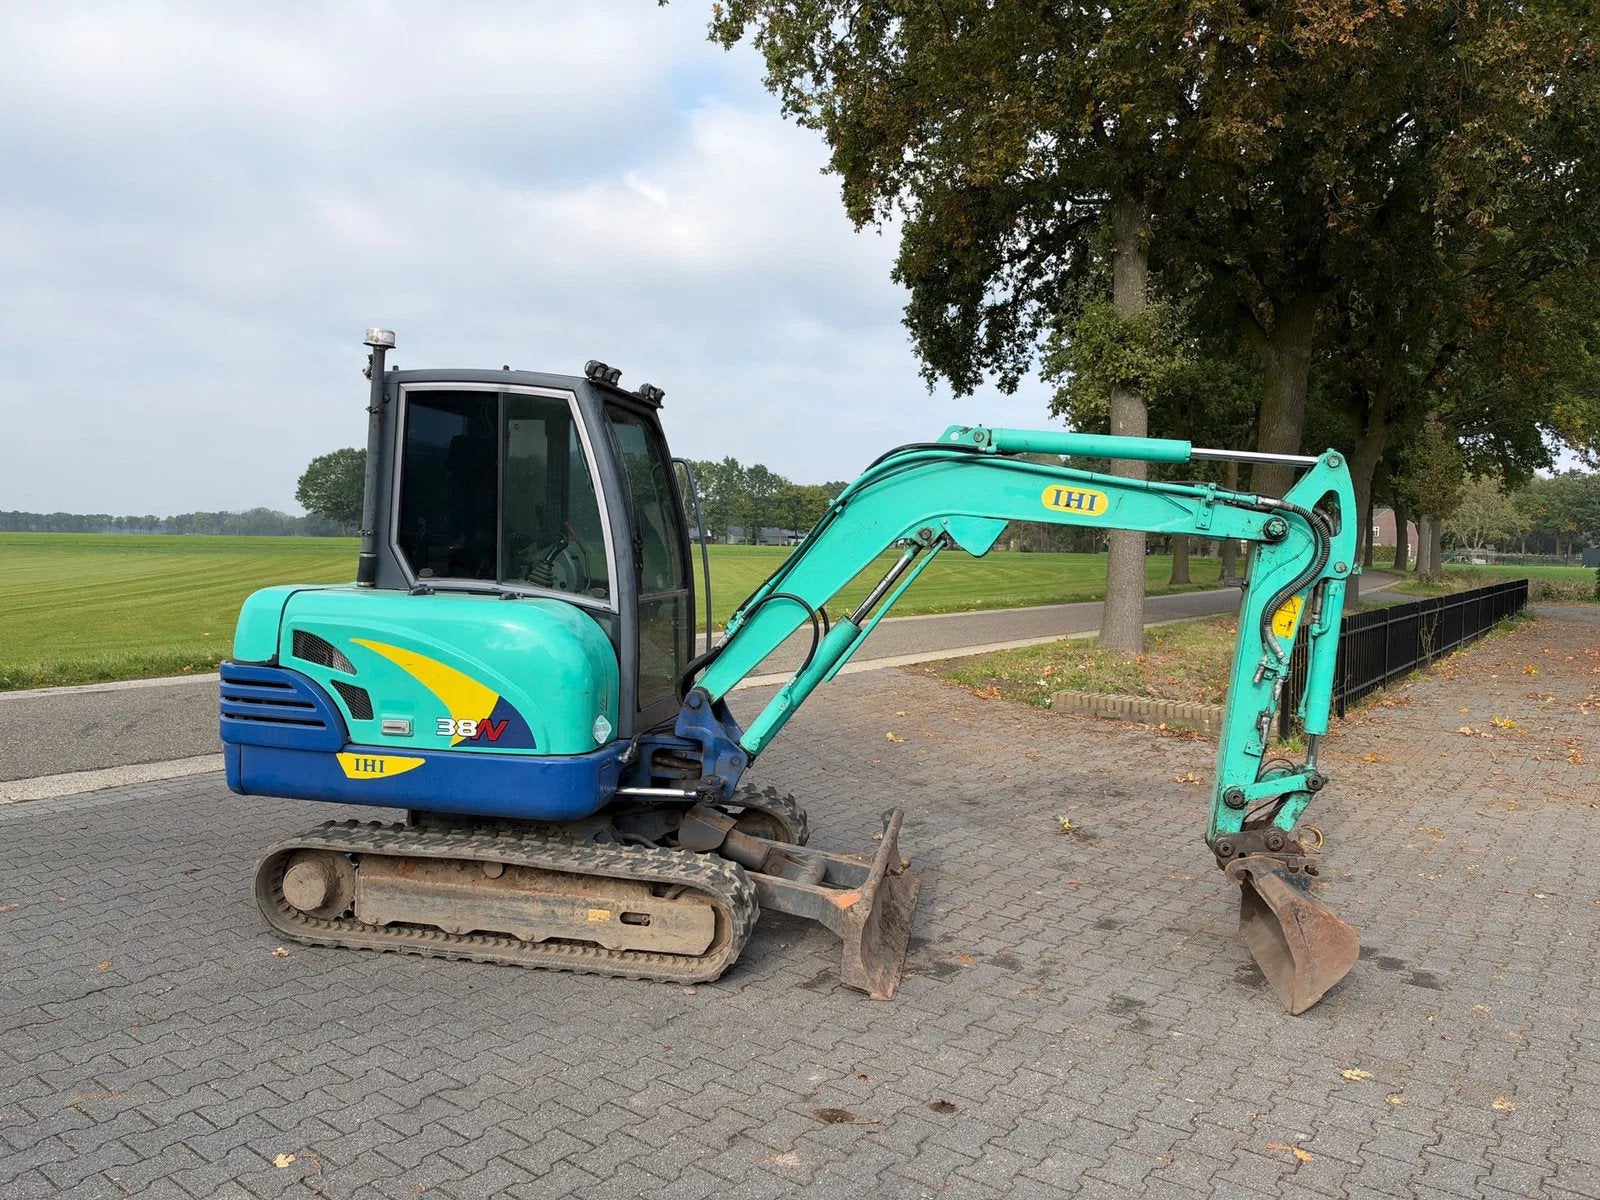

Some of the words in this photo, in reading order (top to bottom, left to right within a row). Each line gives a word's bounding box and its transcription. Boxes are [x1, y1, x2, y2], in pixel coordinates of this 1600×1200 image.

[1052, 488, 1098, 511] IHI
[436, 717, 510, 742] 38N
[354, 757, 385, 773] IHI
